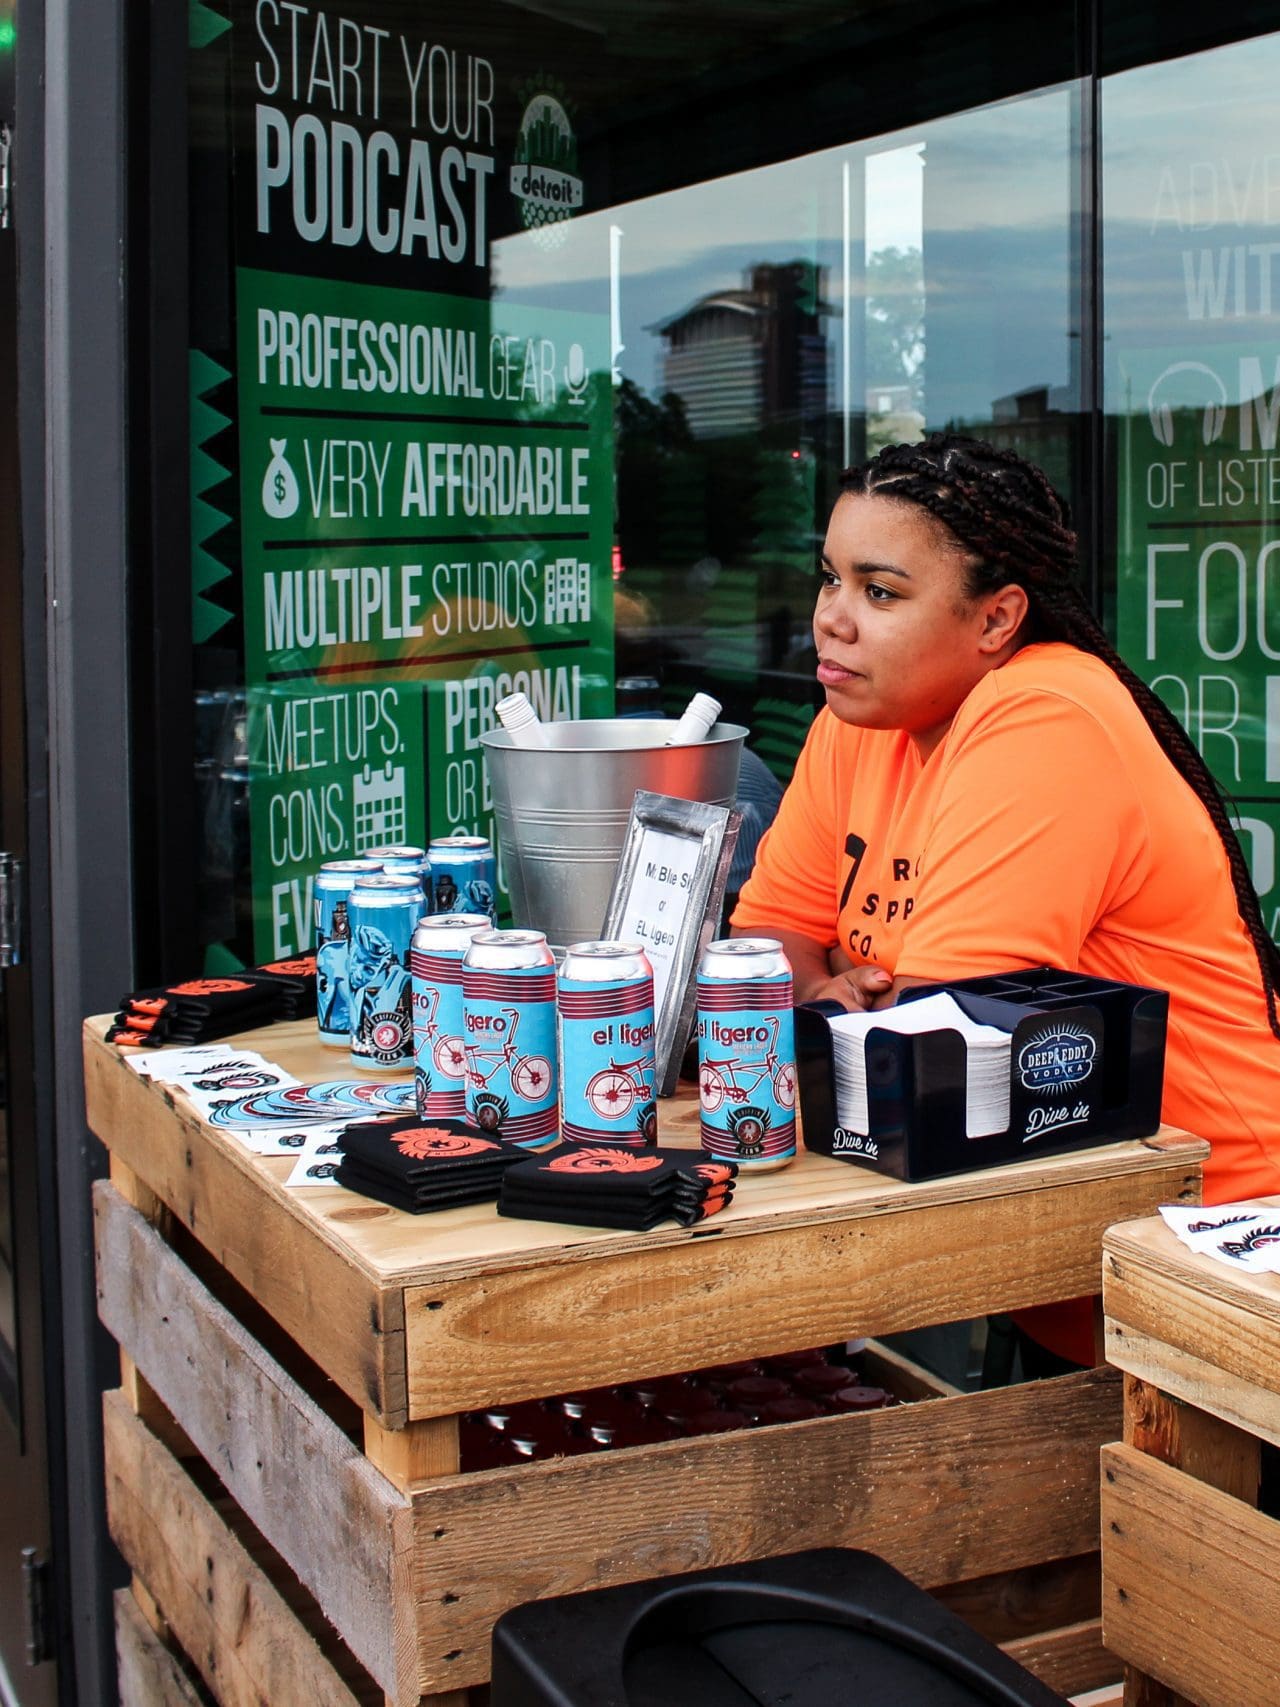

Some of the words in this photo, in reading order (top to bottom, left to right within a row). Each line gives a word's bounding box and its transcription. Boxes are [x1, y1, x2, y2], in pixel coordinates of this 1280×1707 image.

[256, 0, 390, 119] START
[400, 35, 495, 147] YOUR
[256, 104, 495, 268] PODCAST
[521, 164, 574, 203] detroit
[258, 308, 484, 398] PROFESSIONAL
[489, 333, 557, 405] GEAR
[303, 438, 393, 519] VERY
[401, 442, 590, 518] AFFORDABLE
[1147, 462, 1188, 509] OF
[264, 565, 424, 651] MULTIPLE
[432, 559, 538, 636] STUDIOS
[265, 687, 405, 777] MEETUPS.
[445, 760, 476, 824] OR
[269, 782, 350, 867] CONS.
[593, 1024, 614, 1046] el
[711, 1020, 769, 1047] ligero
[1028, 1051, 1055, 1068] DEEP
[1062, 1045, 1088, 1062] EDDY
[833, 1128, 863, 1150] Dive
[864, 1137, 879, 1156] in
[1026, 1105, 1070, 1133] Dive
[1072, 1101, 1090, 1119] in
